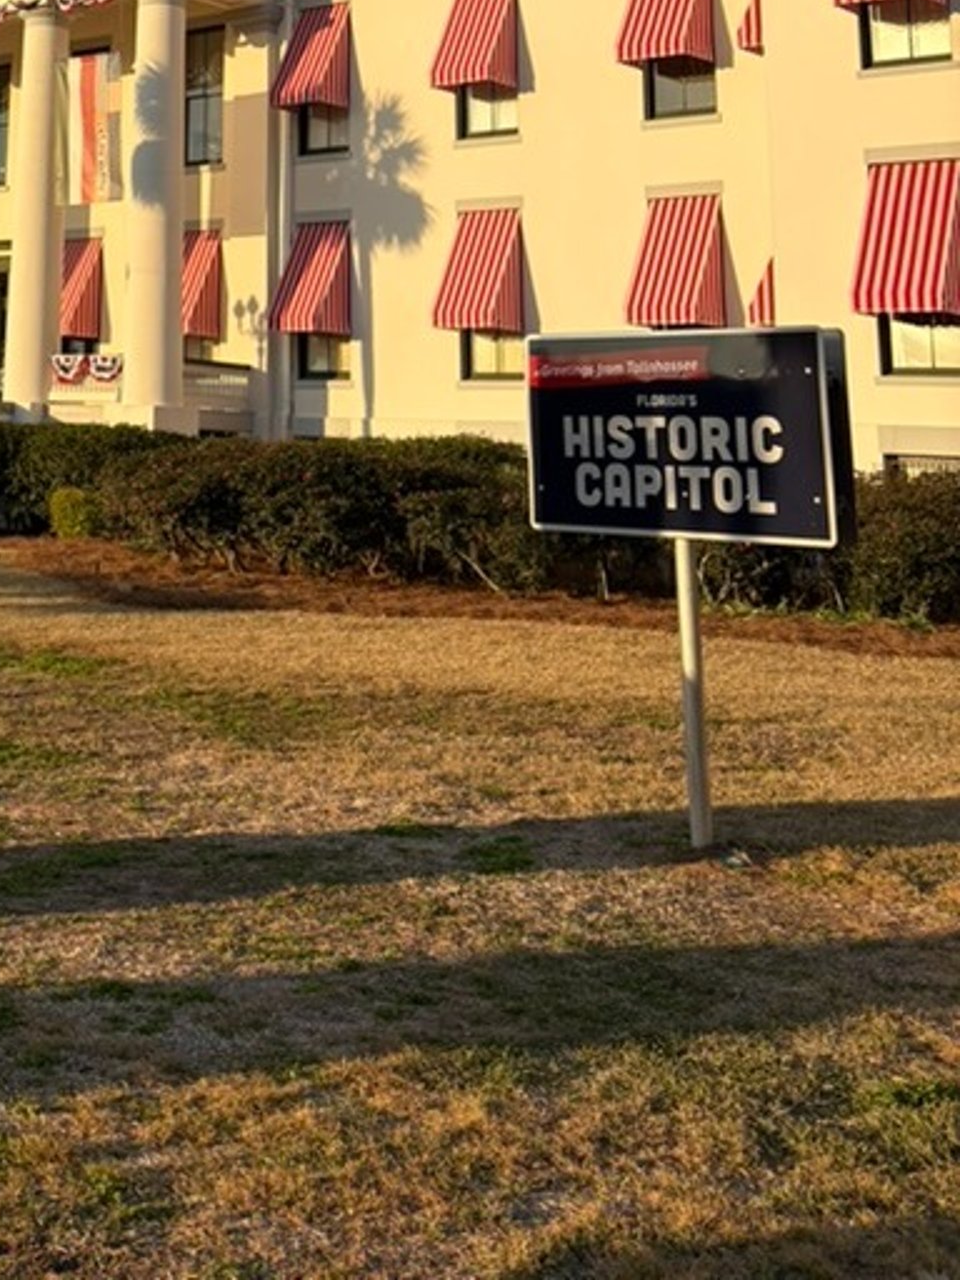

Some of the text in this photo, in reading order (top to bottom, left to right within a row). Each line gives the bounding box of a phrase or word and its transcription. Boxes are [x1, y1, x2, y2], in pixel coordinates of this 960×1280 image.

[636, 394, 697, 408] FLORIDA'S
[562, 415, 784, 463] HISTORIC
[575, 463, 777, 515] CAPITOL
